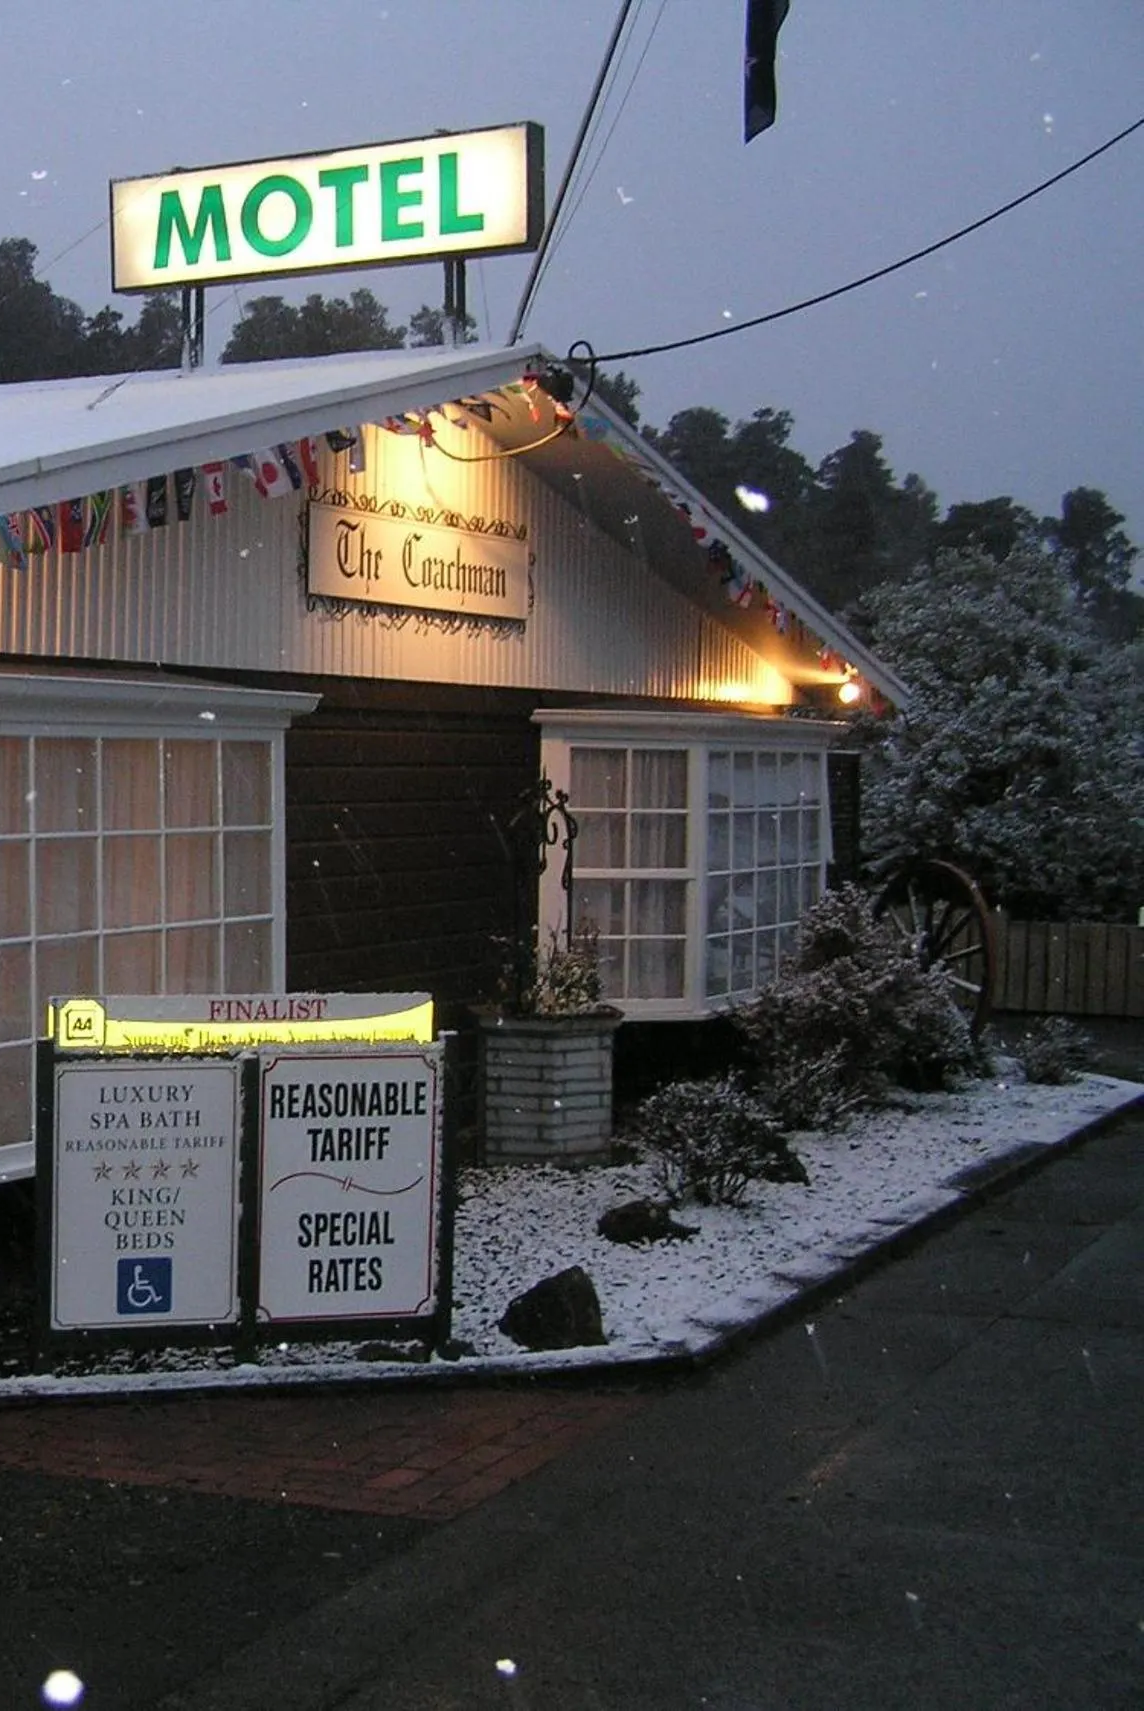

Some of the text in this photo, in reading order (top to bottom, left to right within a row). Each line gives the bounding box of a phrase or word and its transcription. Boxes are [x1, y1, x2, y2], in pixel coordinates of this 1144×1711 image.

[153, 152, 484, 269] MOTEL
[336, 518, 506, 605] The Coachman
[209, 999, 328, 1021] FINALIST
[99, 1084, 194, 1104] LUXURY
[269, 1081, 427, 1119] REASONABLE
[90, 1109, 201, 1130] SPA BATH
[64, 1135, 226, 1153] REASONABLE TARIFF
[306, 1126, 391, 1162] TARIFF
[111, 1186, 181, 1206] KING/
[104, 1209, 186, 1230] QUEEN
[297, 1210, 395, 1249] SPECIAL
[115, 1232, 175, 1250] BEDS
[308, 1256, 383, 1294] RATES
